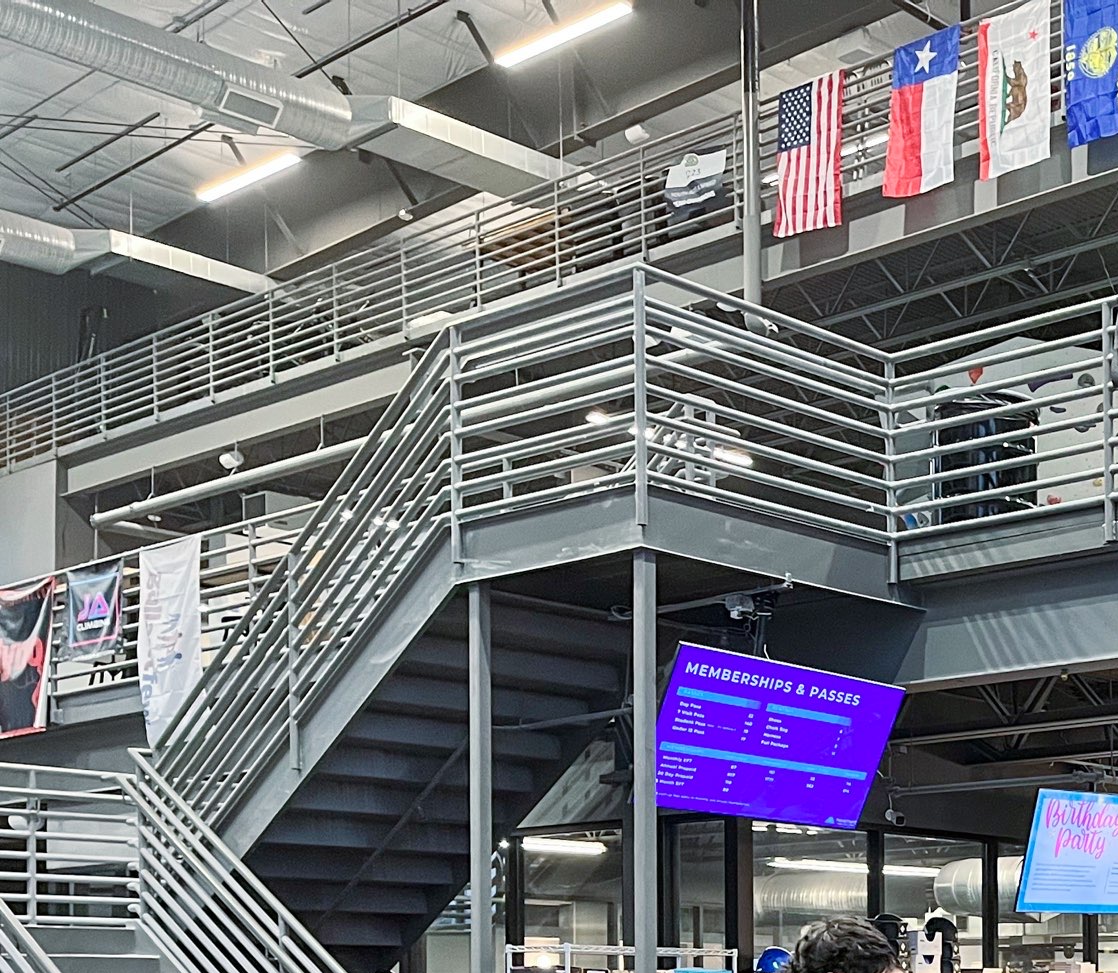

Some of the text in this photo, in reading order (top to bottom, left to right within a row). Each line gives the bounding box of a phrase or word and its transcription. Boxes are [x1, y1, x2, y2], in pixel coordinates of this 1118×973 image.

[685, 661, 860, 706] MEMBERSHIPS & PASSES
